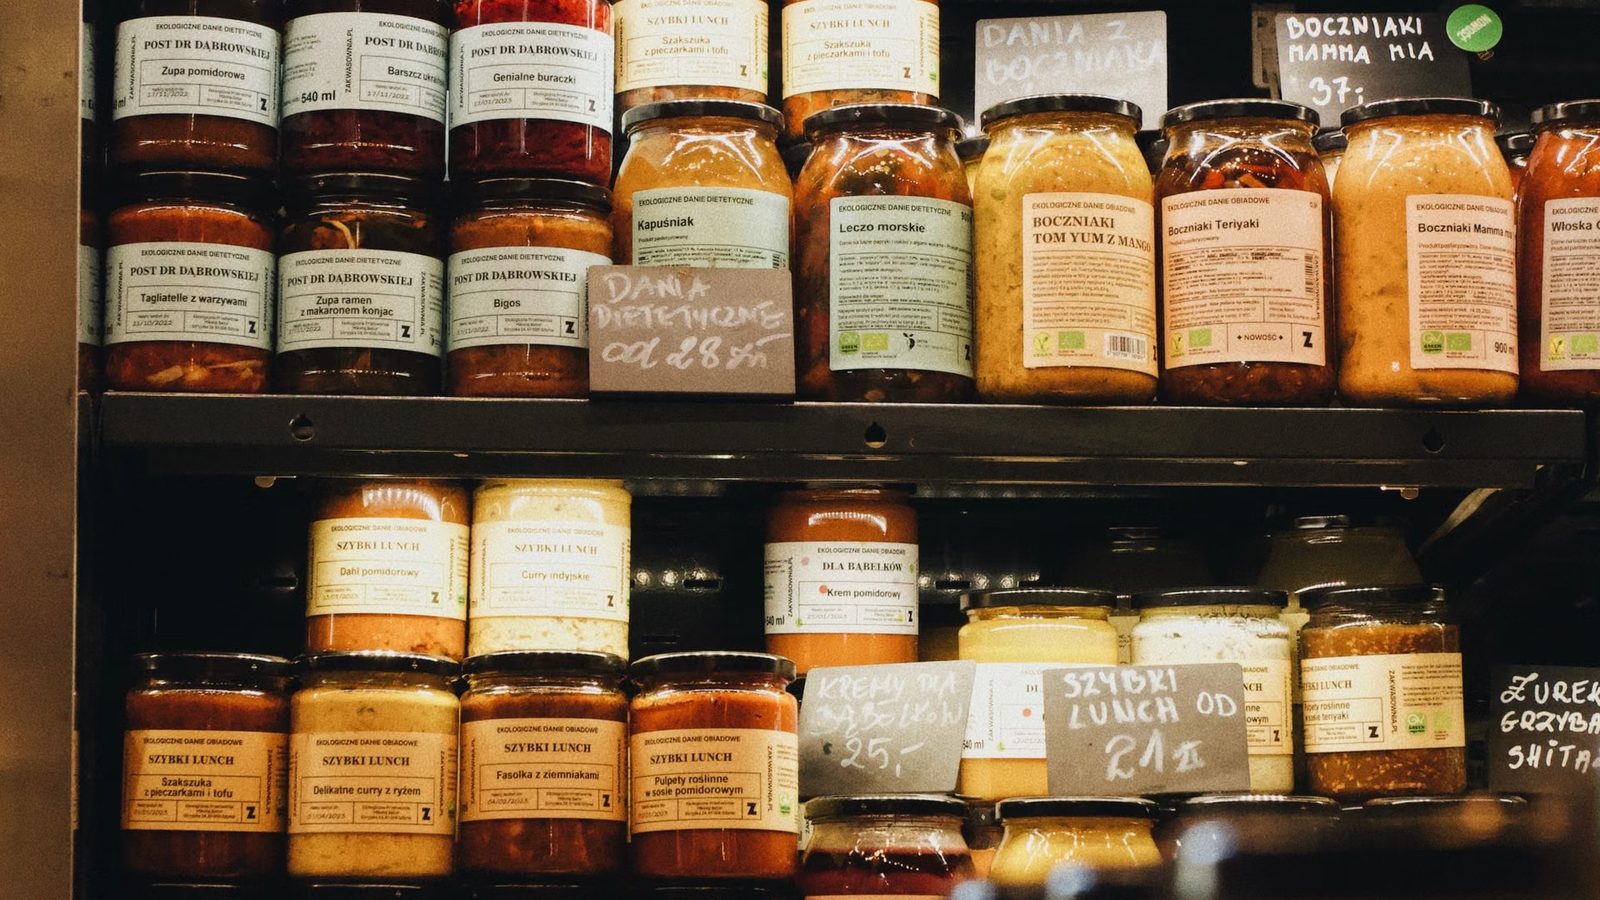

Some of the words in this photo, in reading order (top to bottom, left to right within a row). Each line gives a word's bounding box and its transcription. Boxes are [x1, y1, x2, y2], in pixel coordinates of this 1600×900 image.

[648, 15, 689, 26] SZYBKI
[692, 16, 729, 25] LUNCH
[810, 20, 850, 30] SZYBKI
[852, 19, 891, 28] LUNCH
[1285, 15, 1423, 40] BOCZNIAKI
[984, 20, 1084, 48] DANIA
[364, 35, 395, 47] POST
[398, 38, 414, 50] DR
[662, 36, 711, 45] Szakszuka
[824, 41, 872, 50] Szakszuka
[144, 40, 172, 50] POST
[175, 40, 192, 49] DR
[195, 40, 271, 61] DĄBROWSKIEJ
[471, 46, 498, 59] POST
[500, 45, 516, 55] DR
[519, 45, 598, 61] DĄBROWSKIEJ
[651, 46, 705, 57] pieczarkami
[711, 47, 729, 55] tofu
[813, 50, 866, 61] pieczarkami
[873, 50, 891, 58] tofu
[1287, 43, 1371, 64] MAMMA
[1388, 41, 1434, 62] MIA
[161, 66, 185, 77] Zupa
[187, 68, 246, 82] pomidorowa
[387, 65, 422, 80] Barszcz
[493, 71, 535, 83] Genialne
[537, 72, 577, 84] buraczki
[301, 91, 318, 104] 540
[321, 90, 336, 101] ml
[638, 196, 683, 207] EKOLOGICZNE
[707, 196, 755, 206] DIETETYCZNE
[1208, 198, 1229, 206] DANIE
[1416, 203, 1465, 211] EKOLOGICZNE
[1466, 204, 1485, 212] DANIE
[839, 203, 886, 213] EKOLOGICZNE
[888, 204, 909, 212] DANIE
[638, 215, 695, 231] Kapuśniak
[839, 223, 874, 233] Leczo
[877, 222, 926, 233] morskie
[1033, 216, 1115, 229] BOCZNIAKI
[1168, 221, 1213, 237] Boczniaki
[1215, 219, 1260, 231] Teriyaki
[1551, 221, 1592, 232] Włoska
[1418, 222, 1471, 233] Boczniaki
[1474, 223, 1504, 236] Mamma
[1032, 232, 1066, 244] TOM
[1069, 232, 1104, 244] YUM
[1107, 233, 1116, 245] Z
[1118, 235, 1151, 253] MANGO
[141, 249, 186, 257] EKOLOGICZNE
[130, 266, 157, 277] POST
[160, 266, 177, 276] DR
[180, 267, 260, 283] DĄBROWSKIEJ
[287, 275, 308, 287] POST
[310, 274, 325, 284] DR
[328, 273, 413, 287] DĄBROWSKIEJ
[454, 273, 473, 286] POST
[475, 271, 490, 282] DR
[492, 270, 577, 283] DĄBROWSKIEJ
[141, 293, 188, 305] Tagliatelle
[199, 296, 248, 307] warzywami
[316, 295, 340, 306] Zupa
[342, 295, 372, 305] ramen
[493, 298, 521, 309] Bigos
[300, 309, 305, 317] z
[306, 307, 360, 317] makaronem
[362, 306, 395, 317] konjac
[1302, 332, 1313, 348] Z
[665, 335, 723, 370] 28
[1494, 341, 1508, 354] 900
[337, 541, 378, 551] SZYBKI
[381, 541, 420, 551] LUNCH
[515, 543, 557, 553] SZYBKI
[561, 544, 598, 555] LUNCH
[340, 566, 360, 577] Dahl
[362, 568, 420, 578] pomidorowy
[823, 562, 845, 571] DLA
[848, 561, 904, 573] BĄBELKÓW
[522, 570, 547, 581] Curry
[550, 570, 591, 582] indyjskie
[827, 588, 851, 597] Krem
[854, 589, 902, 600] pomidorowy
[780, 615, 790, 626] ml
[1063, 668, 1178, 698] SZYBKI
[1321, 680, 1353, 691] LUNCH
[1069, 697, 1180, 729] LUNCH
[1196, 691, 1237, 717] OD
[1320, 701, 1350, 711] roślinne
[1323, 711, 1349, 723] teriyaki
[504, 744, 549, 753] SZYBKI
[552, 743, 592, 754] LUNCH
[974, 739, 984, 749] ml
[149, 754, 190, 765] SZYBKI
[193, 755, 235, 766] LUNCH
[650, 753, 688, 765] SZYBKI
[692, 752, 732, 763] LUNCH
[1104, 728, 1164, 781] 21
[322, 756, 365, 766] SZYBKI
[369, 756, 410, 767] LUNCH
[496, 770, 533, 780] Fasolka
[543, 769, 600, 780] ziemniakami
[655, 776, 686, 787] Pulpety
[689, 774, 729, 785] roślinne
[162, 777, 212, 788] Szakszuka
[150, 787, 205, 798] pieczarkami
[213, 788, 233, 799] tofu
[313, 785, 354, 796] Delikatne
[357, 787, 383, 797] curry
[393, 786, 421, 797] ryżem
[652, 787, 673, 797] sosie
[675, 785, 744, 797] pomidorowym
